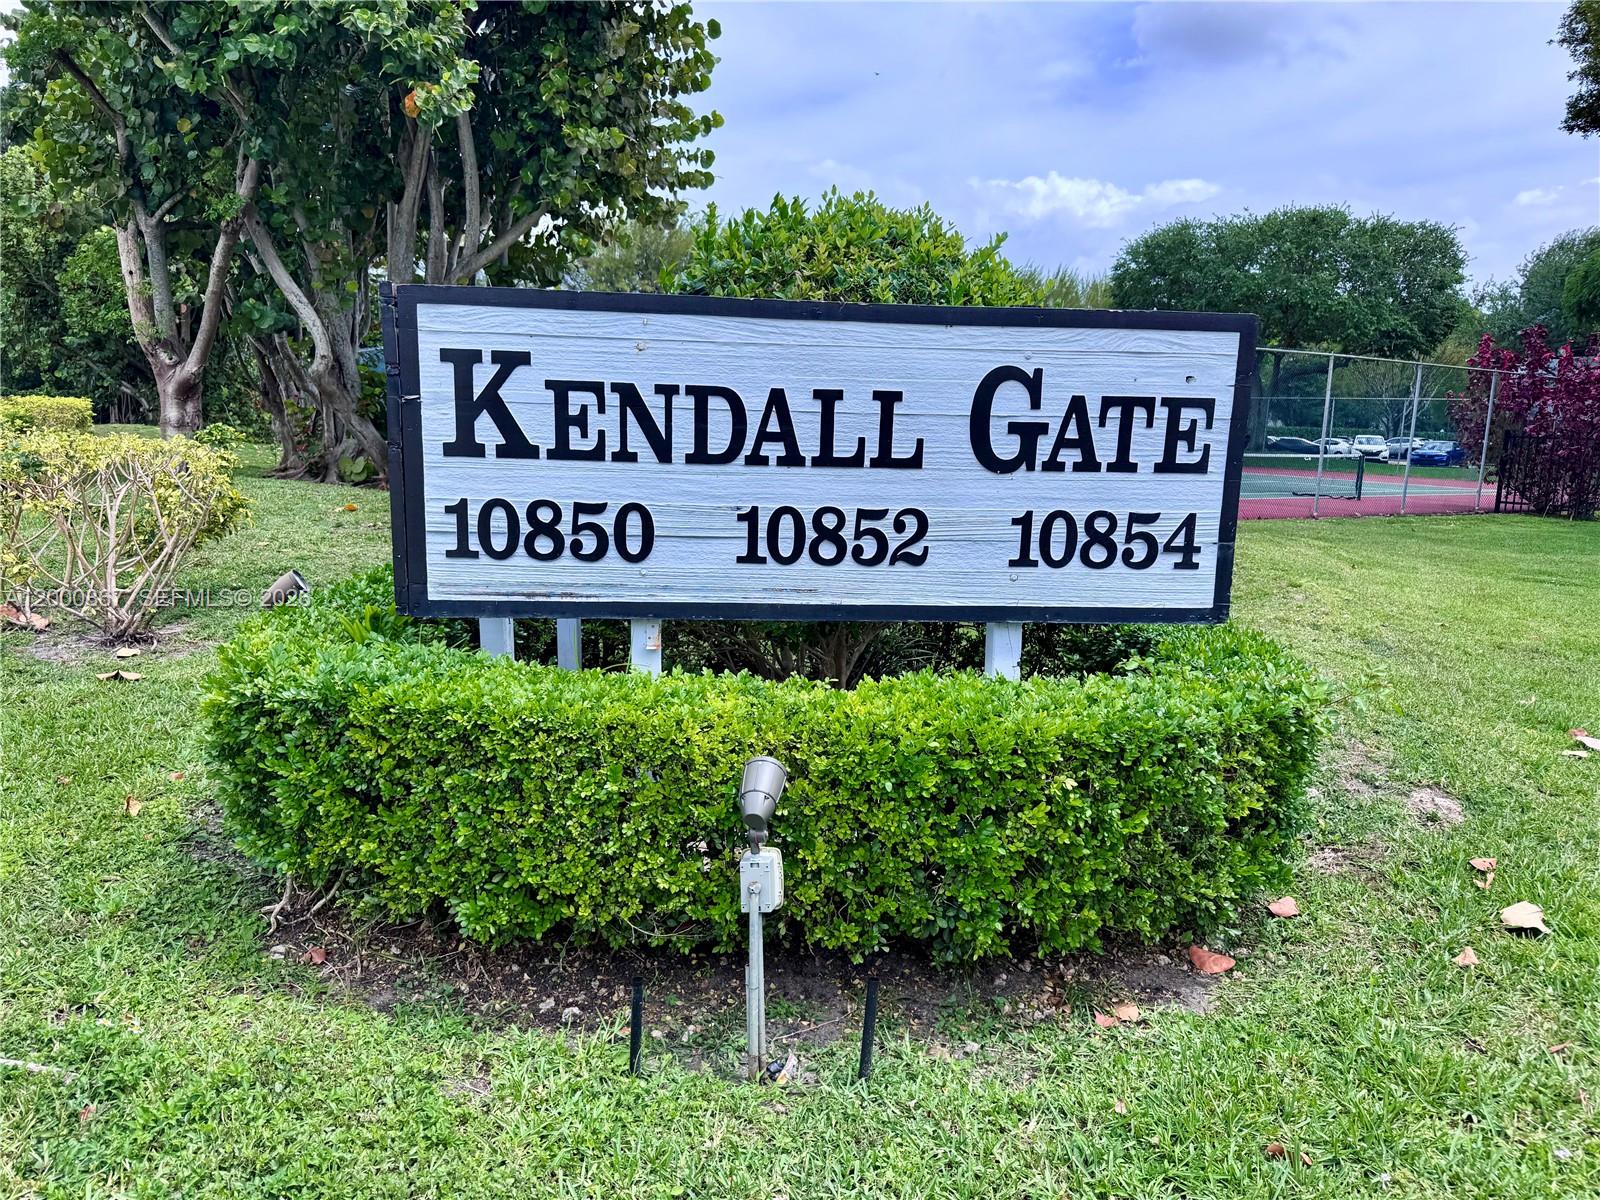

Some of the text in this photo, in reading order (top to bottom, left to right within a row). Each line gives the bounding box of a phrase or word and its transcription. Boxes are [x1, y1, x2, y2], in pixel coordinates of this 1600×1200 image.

[440, 348, 1216, 475] KENDALL GATE
[445, 498, 1202, 570] 10850 10852 10854
